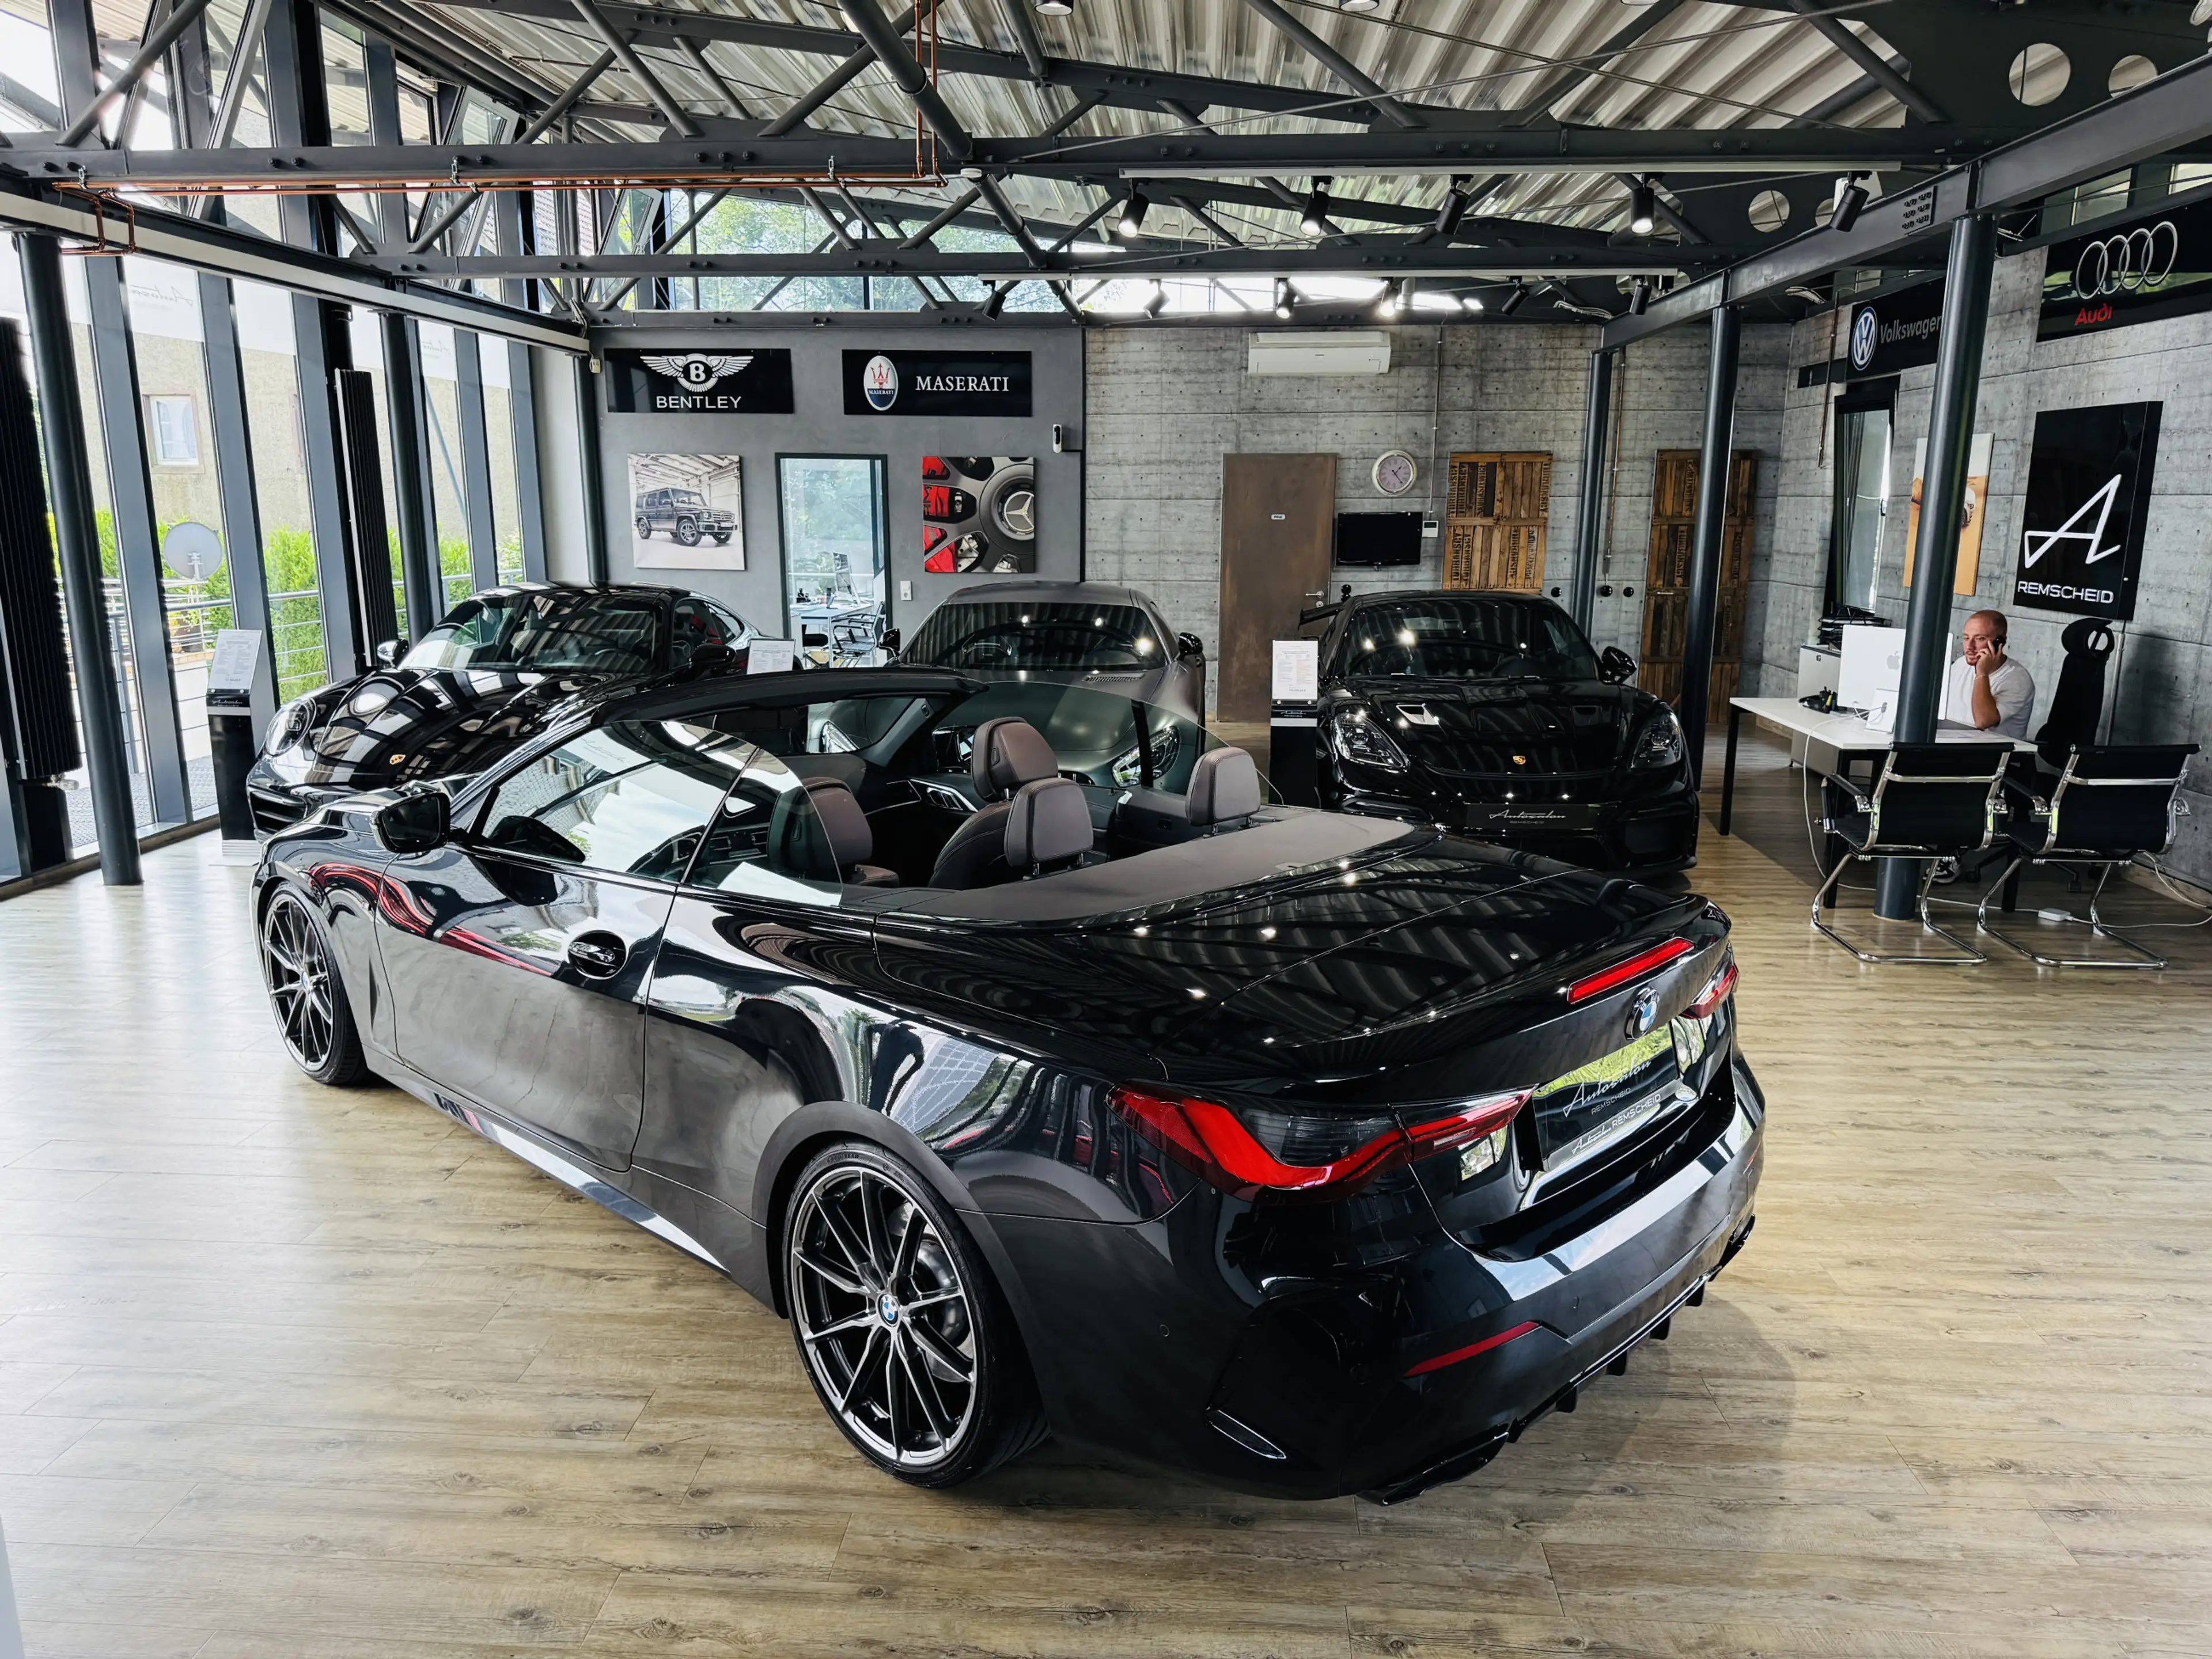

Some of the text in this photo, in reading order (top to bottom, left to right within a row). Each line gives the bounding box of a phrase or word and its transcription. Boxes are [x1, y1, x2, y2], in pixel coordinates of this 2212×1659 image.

[2074, 303, 2113, 327] Audi
[915, 376, 1009, 392] MASERATI
[656, 396, 742, 408] BENTLEY
[2017, 581, 2114, 604] REMSCHEID
[1489, 809, 1566, 819] Autosalon
[1563, 1055, 1652, 1118] Autosalon
[1590, 1087, 1632, 1116] REMSCHEID
[1611, 1093, 1661, 1129] REMSCHEID
